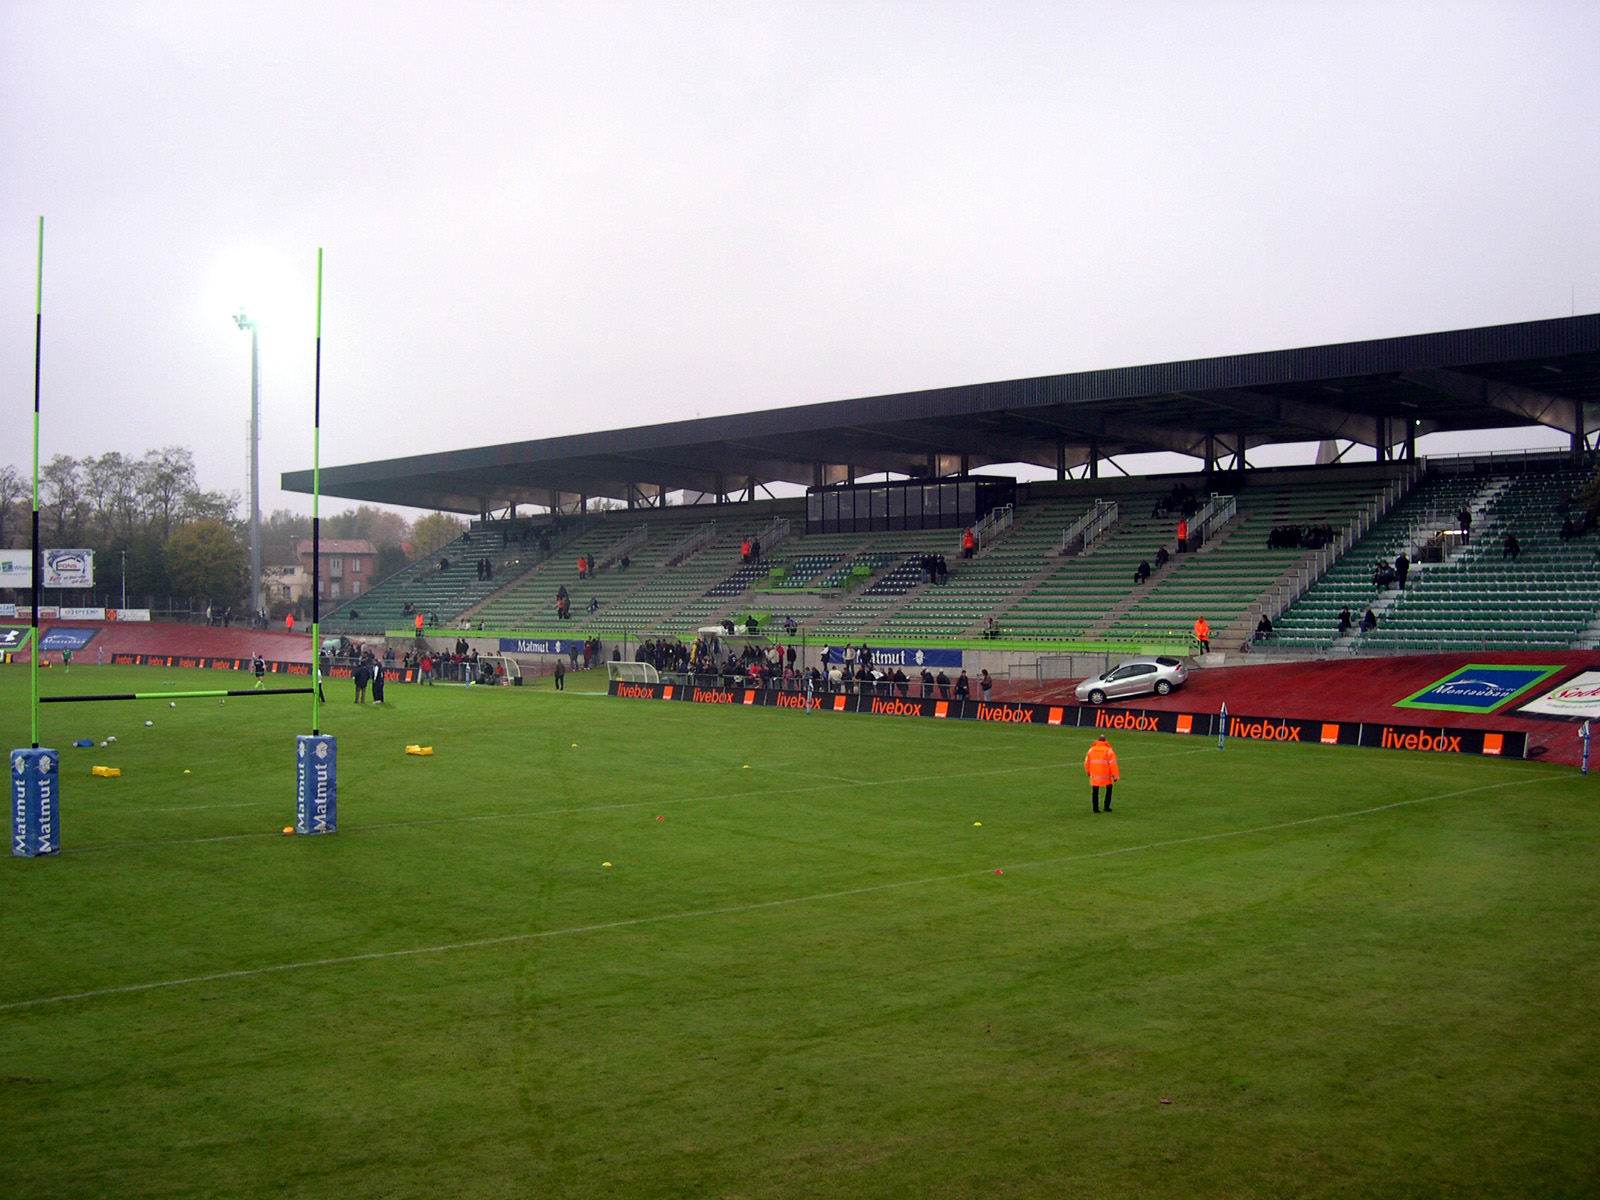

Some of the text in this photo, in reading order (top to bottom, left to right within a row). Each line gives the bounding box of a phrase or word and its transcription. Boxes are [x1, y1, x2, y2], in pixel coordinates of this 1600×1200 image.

[517, 640, 550, 653] Matmut
[617, 682, 655, 699] livebox
[692, 687, 734, 704] livebox
[1431, 685, 1510, 697] Montauban
[871, 697, 922, 717] livebox
[976, 702, 1034, 723] livebox
[1095, 709, 1159, 732] livebox
[1229, 717, 1301, 742] livebox
[1381, 727, 1462, 753] livebox
[314, 763, 328, 833] Matmut
[15, 778, 26, 853] Matmut
[38, 778, 52, 853] Matmut
